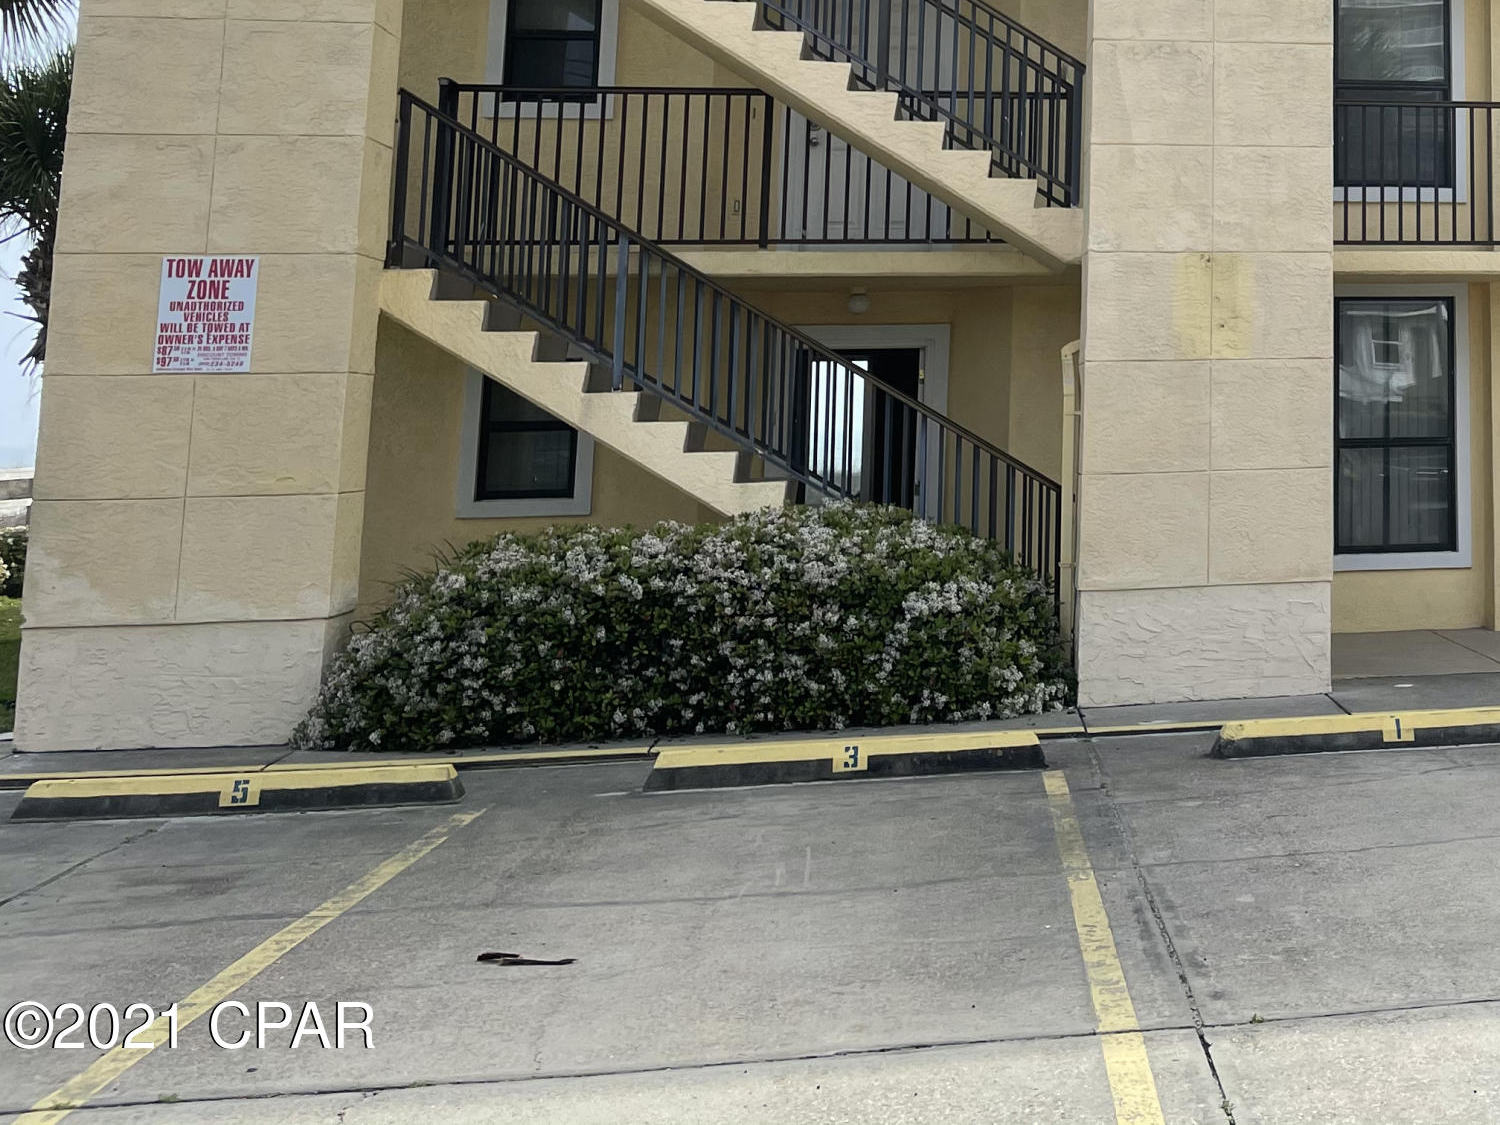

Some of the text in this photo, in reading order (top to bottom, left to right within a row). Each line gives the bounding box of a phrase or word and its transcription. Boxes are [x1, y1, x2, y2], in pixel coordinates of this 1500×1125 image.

[167, 259, 255, 278] TOW AWAY
[187, 280, 230, 299] ZONE
[169, 301, 244, 311] UNAUTHORIZED
[183, 312, 229, 322] VEHICLES
[160, 323, 250, 333] WILL BE TOWED AT
[158, 334, 250, 345] OWNER'S EXPENSE
[1394, 718, 1402, 740] 1
[843, 746, 859, 768] 3
[231, 779, 250, 803] 5
